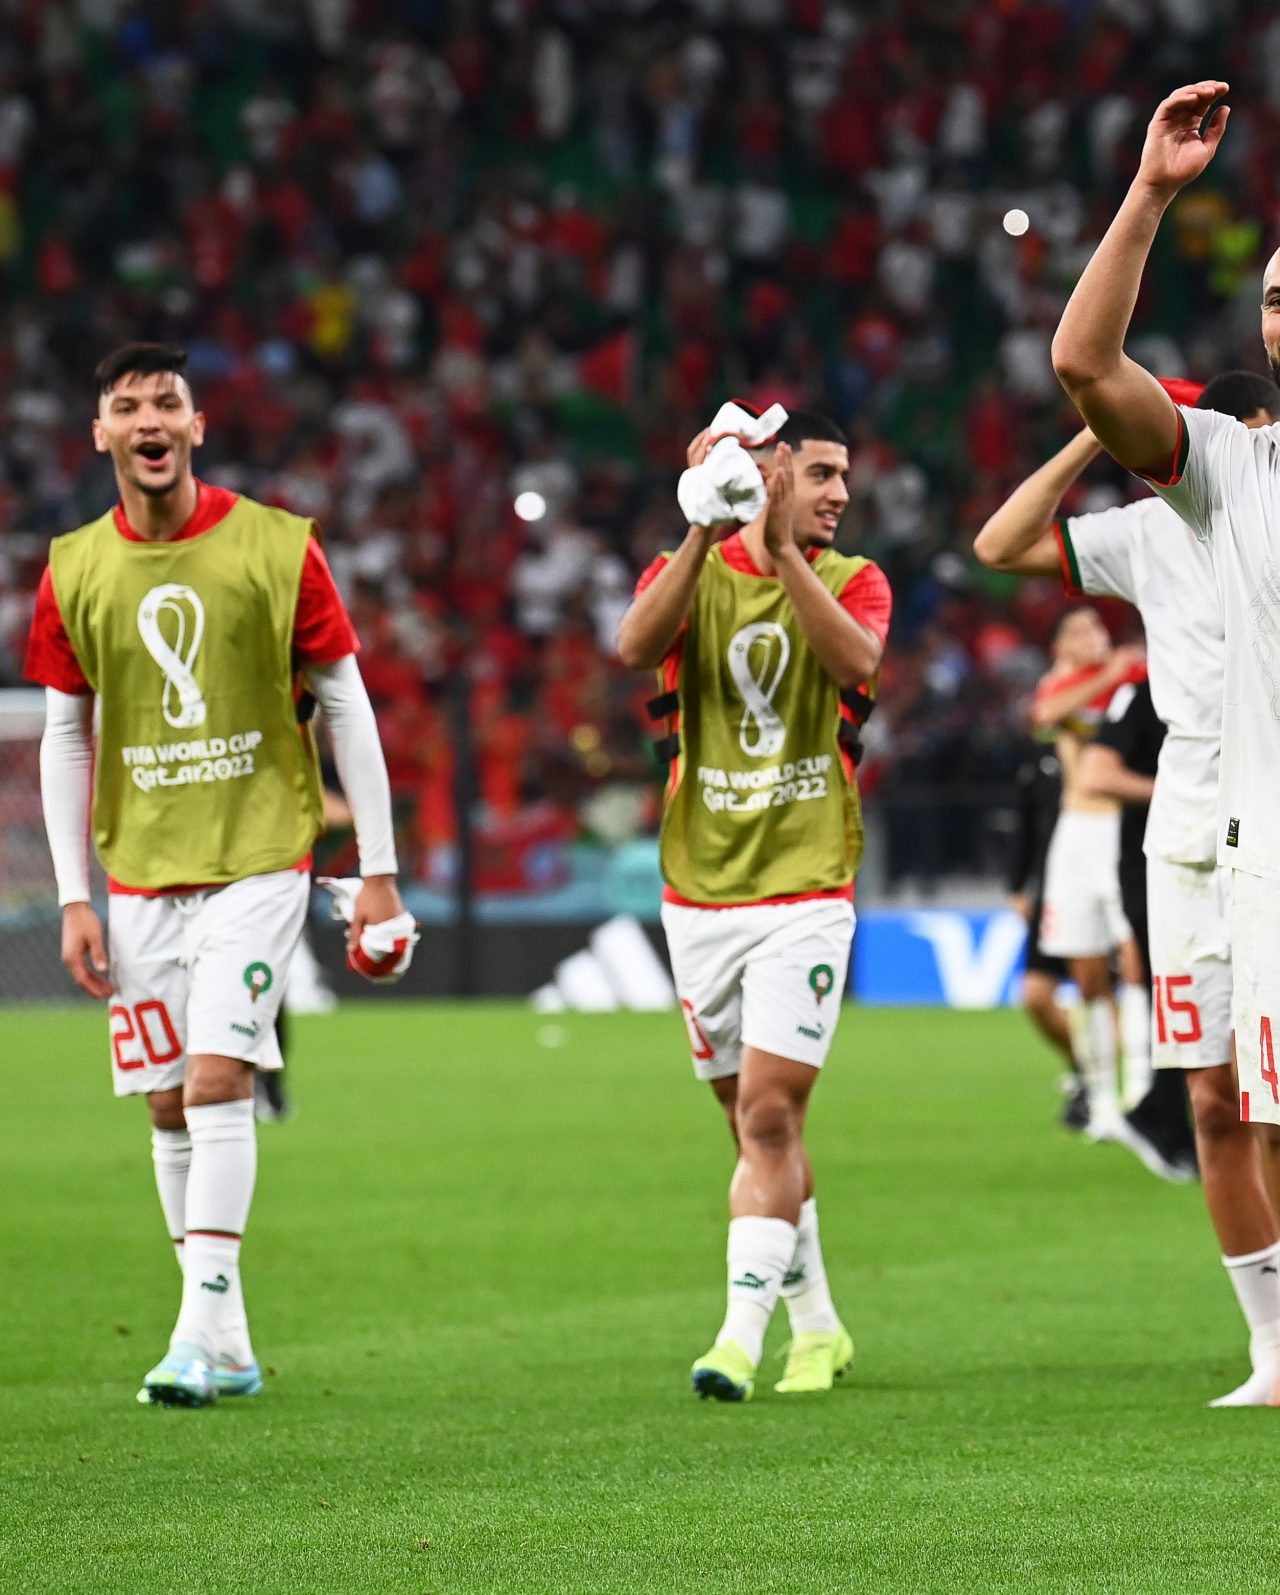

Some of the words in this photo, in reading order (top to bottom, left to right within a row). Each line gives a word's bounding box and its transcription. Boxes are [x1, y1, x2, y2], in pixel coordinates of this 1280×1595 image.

[156, 737, 228, 763] WORLD
[229, 730, 264, 754] CUP
[728, 762, 795, 790] WORLD
[794, 753, 833, 778] CUP
[111, 1000, 184, 1072] 20
[1154, 974, 1203, 1043] 15
[1260, 1016, 1280, 1104] 4
